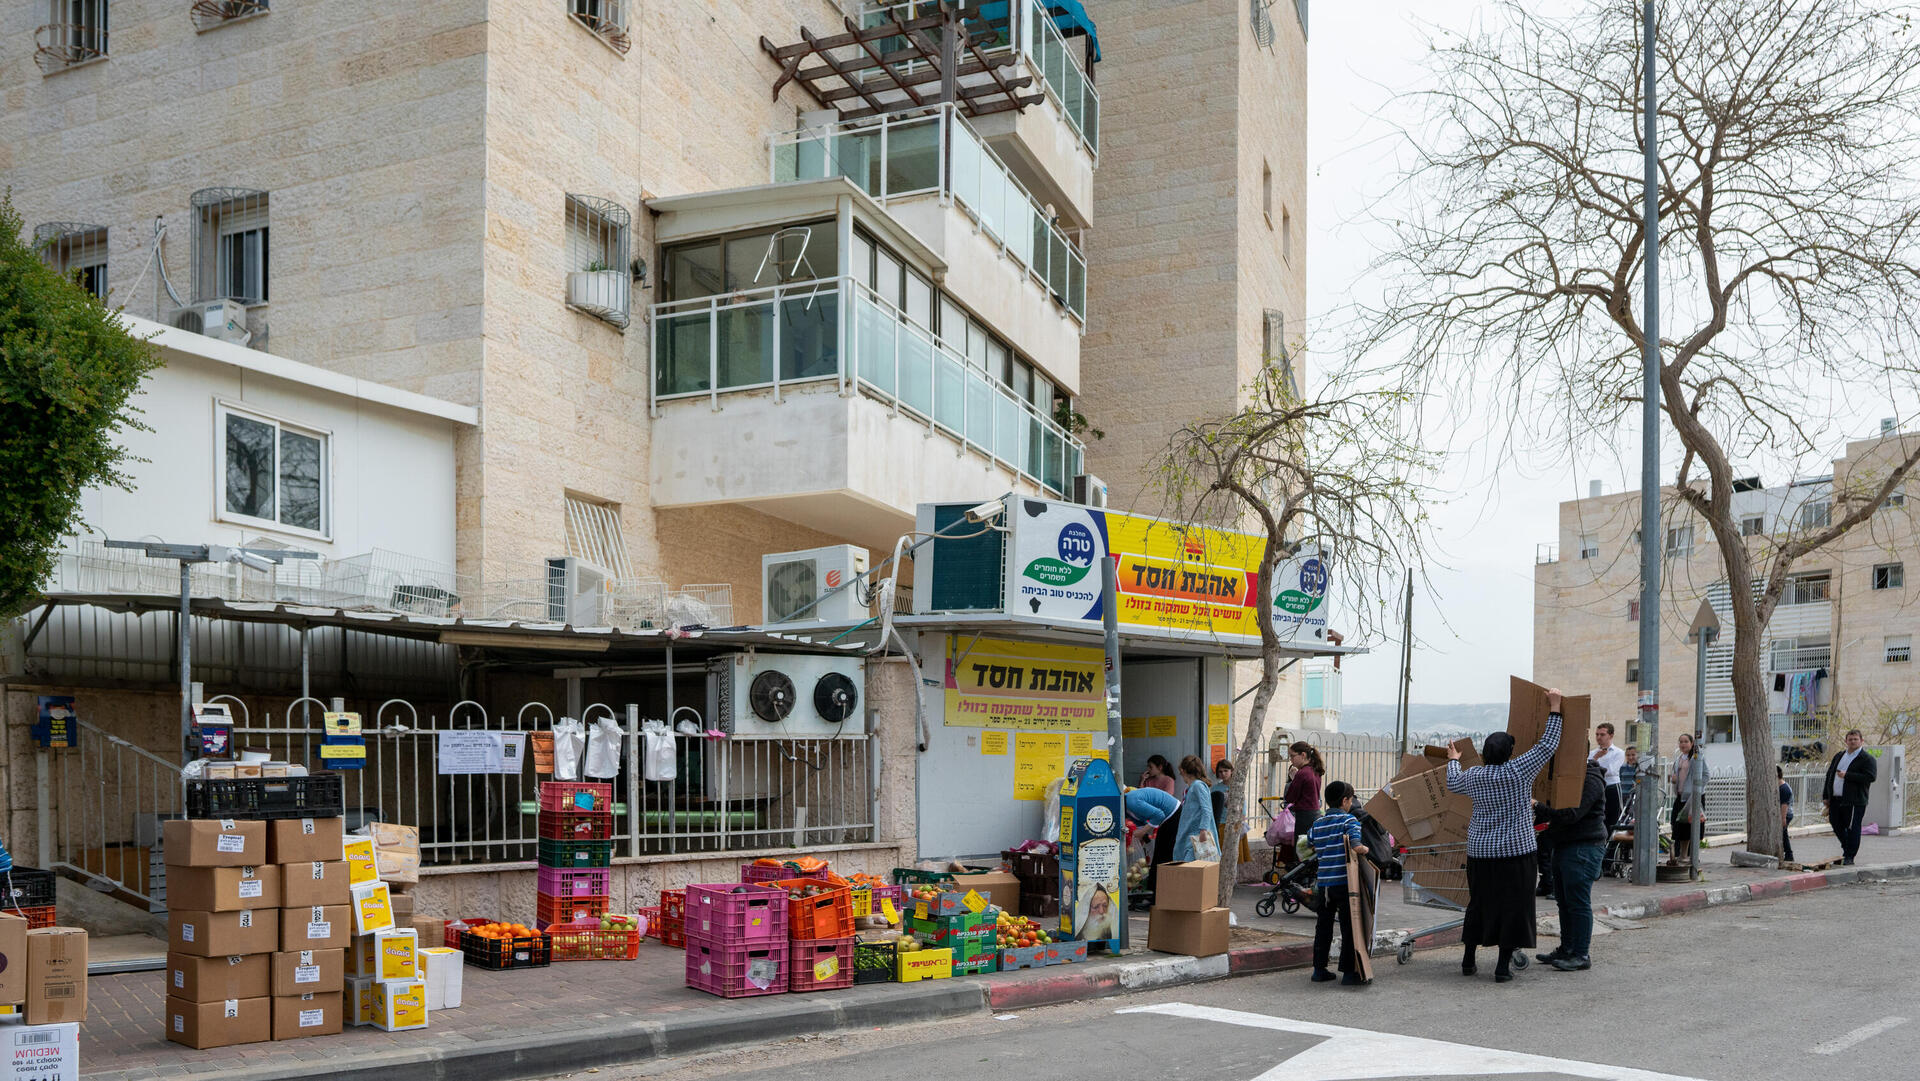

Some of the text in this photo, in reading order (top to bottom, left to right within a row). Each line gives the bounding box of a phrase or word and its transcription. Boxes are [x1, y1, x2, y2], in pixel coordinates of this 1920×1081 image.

[1063, 537, 1090, 552] טרה
[1034, 564, 1072, 575] ללא חומרים
[1040, 573, 1066, 582] משמרים
[1132, 564, 1238, 598] אהבת חסד
[1022, 586, 1093, 600] להכניס טוב הביתה
[1125, 597, 1242, 620] עושים הכל שתקנה בזול!
[1273, 614, 1291, 622] הביתה
[1305, 617, 1325, 626] להכניס
[972, 663, 1095, 694] אהבת חסד
[957, 699, 1095, 718] עושים הכל שתקנה בזול!
[15, 1047, 60, 1058] MEDIUM
